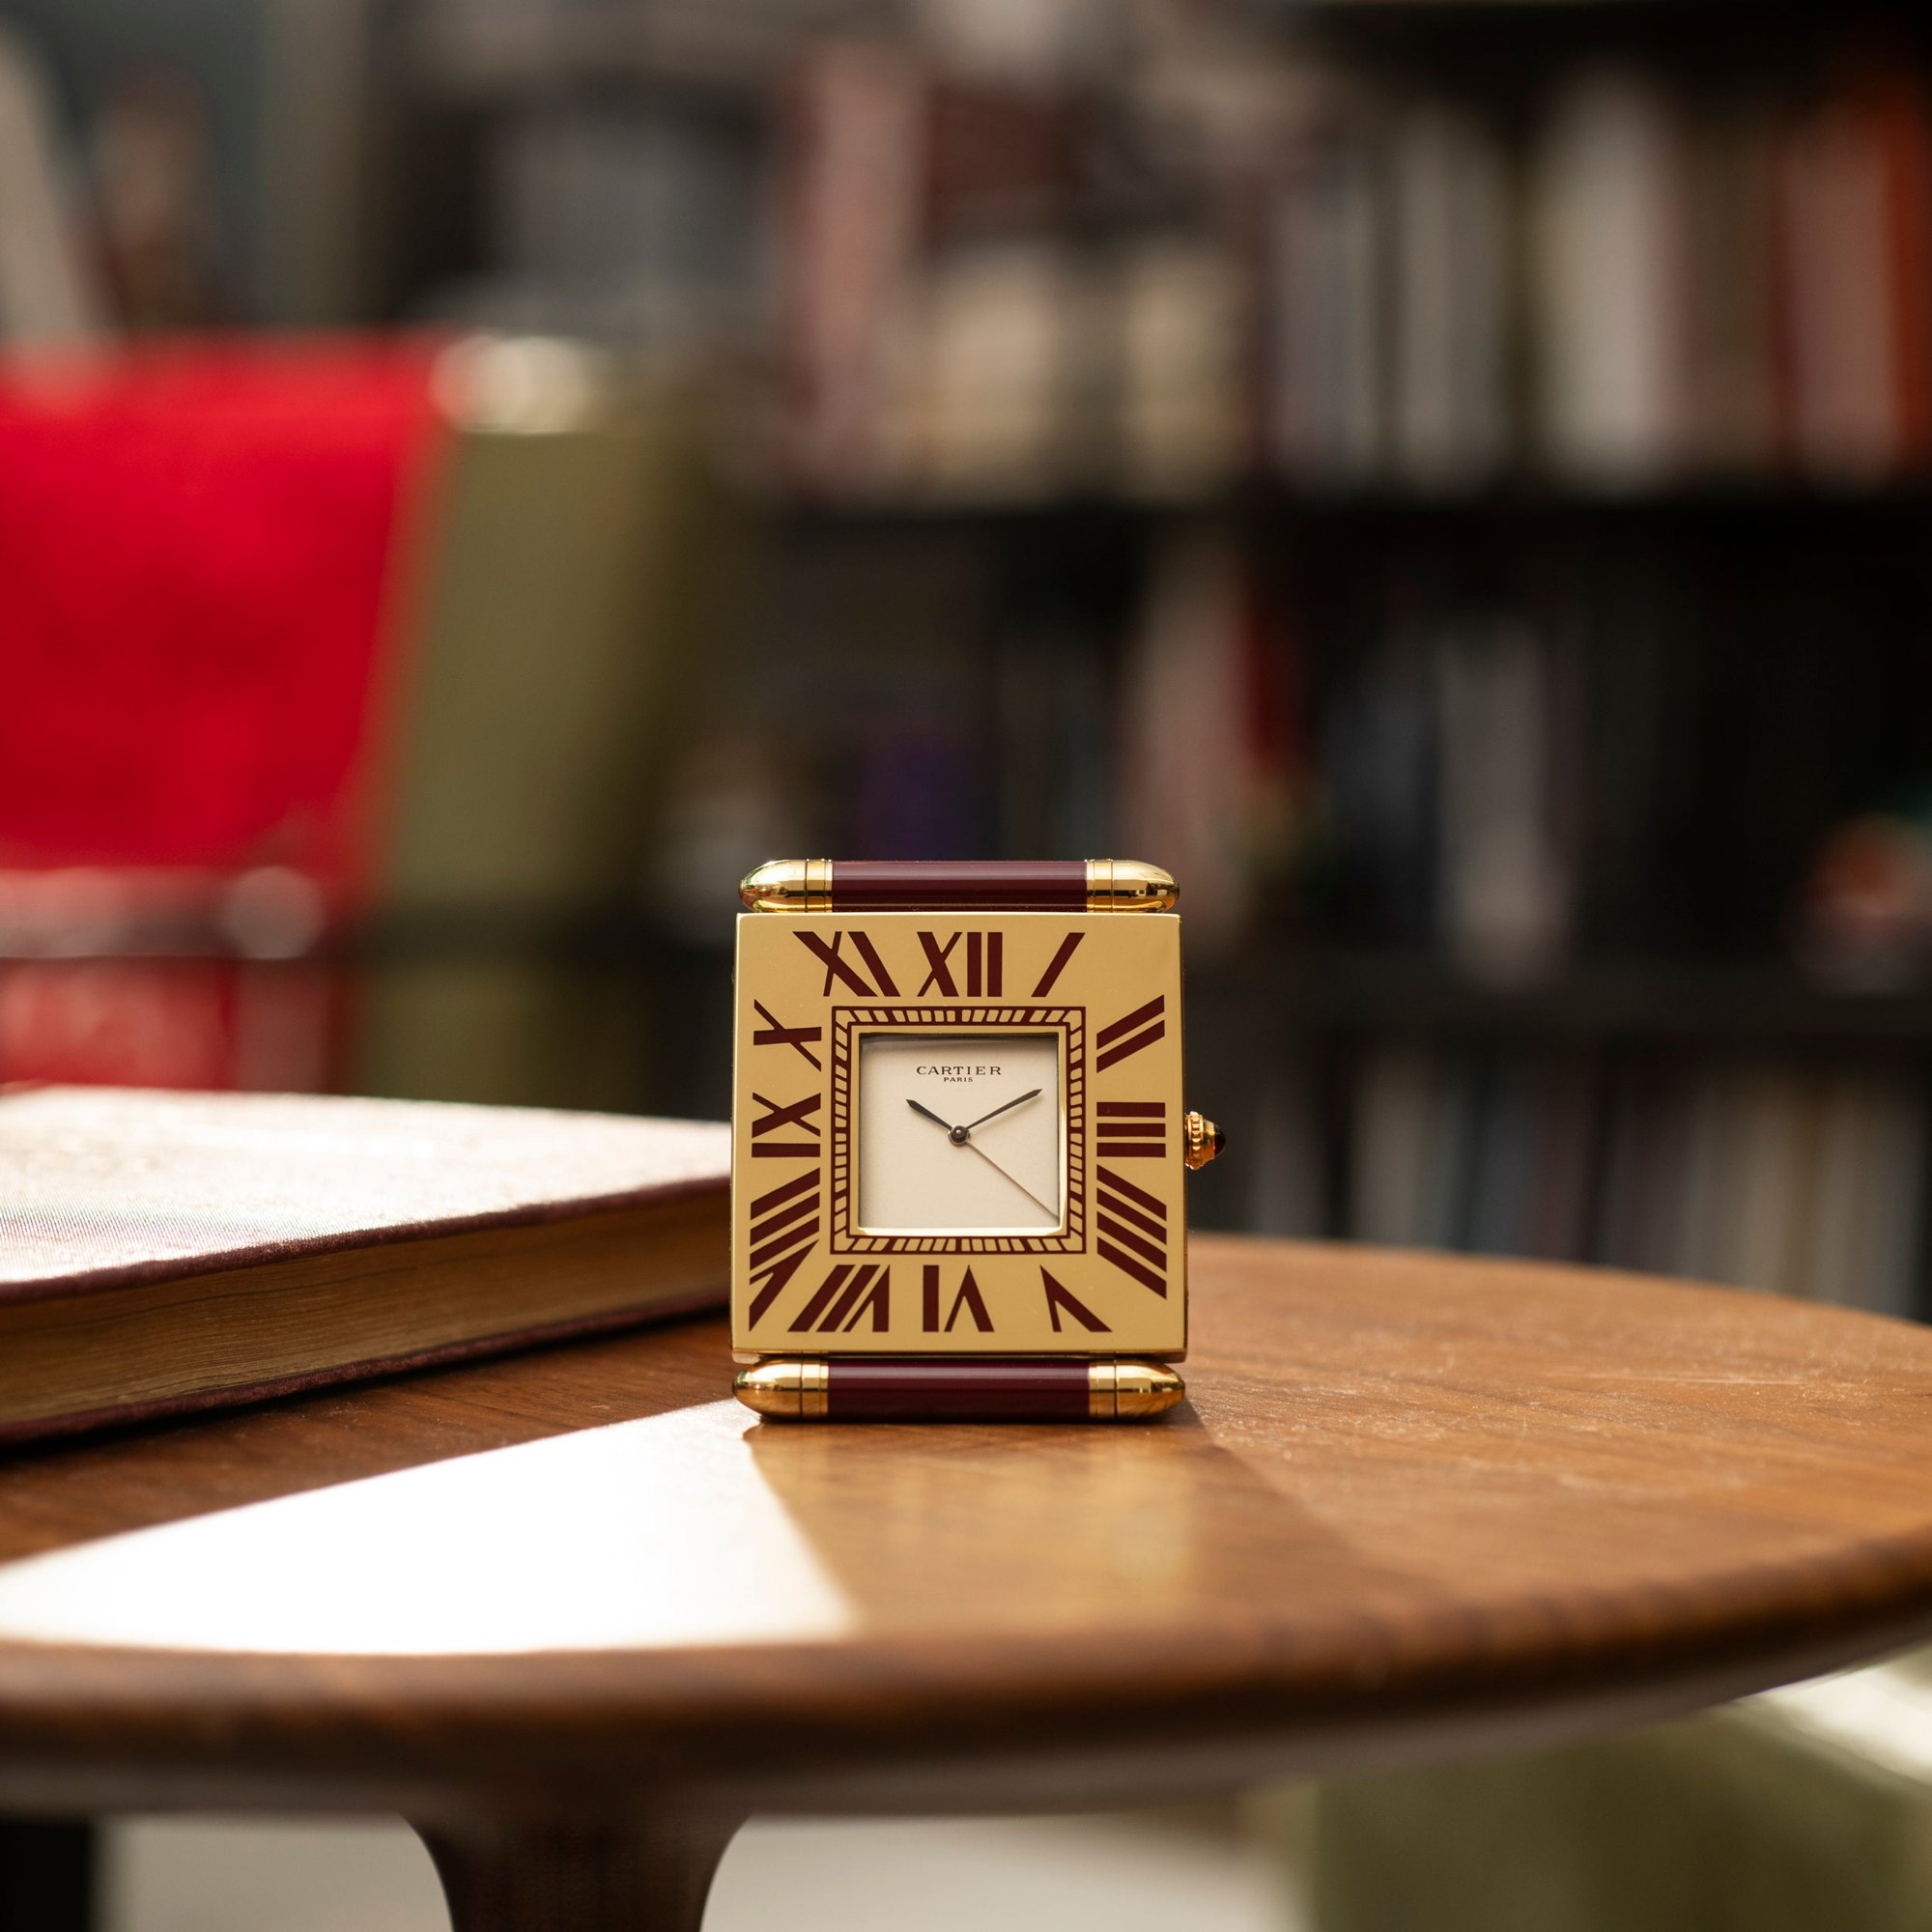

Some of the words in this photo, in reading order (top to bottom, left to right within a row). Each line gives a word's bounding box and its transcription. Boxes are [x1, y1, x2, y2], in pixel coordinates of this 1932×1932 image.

[793, 931, 900, 997] XI
[917, 932, 1003, 997] XII
[1032, 932, 1085, 997] I
[753, 1000, 821, 1071] X
[1096, 995, 1165, 1073] II
[916, 1065, 1002, 1076] CARTIER
[752, 1093, 821, 1157] IX
[1096, 1102, 1166, 1157] III
[749, 1167, 820, 1332] VIII
[1096, 1165, 1167, 1299] IIII
[787, 1264, 891, 1332] VII
[923, 1264, 994, 1332] VI
[1039, 1264, 1113, 1332] V
